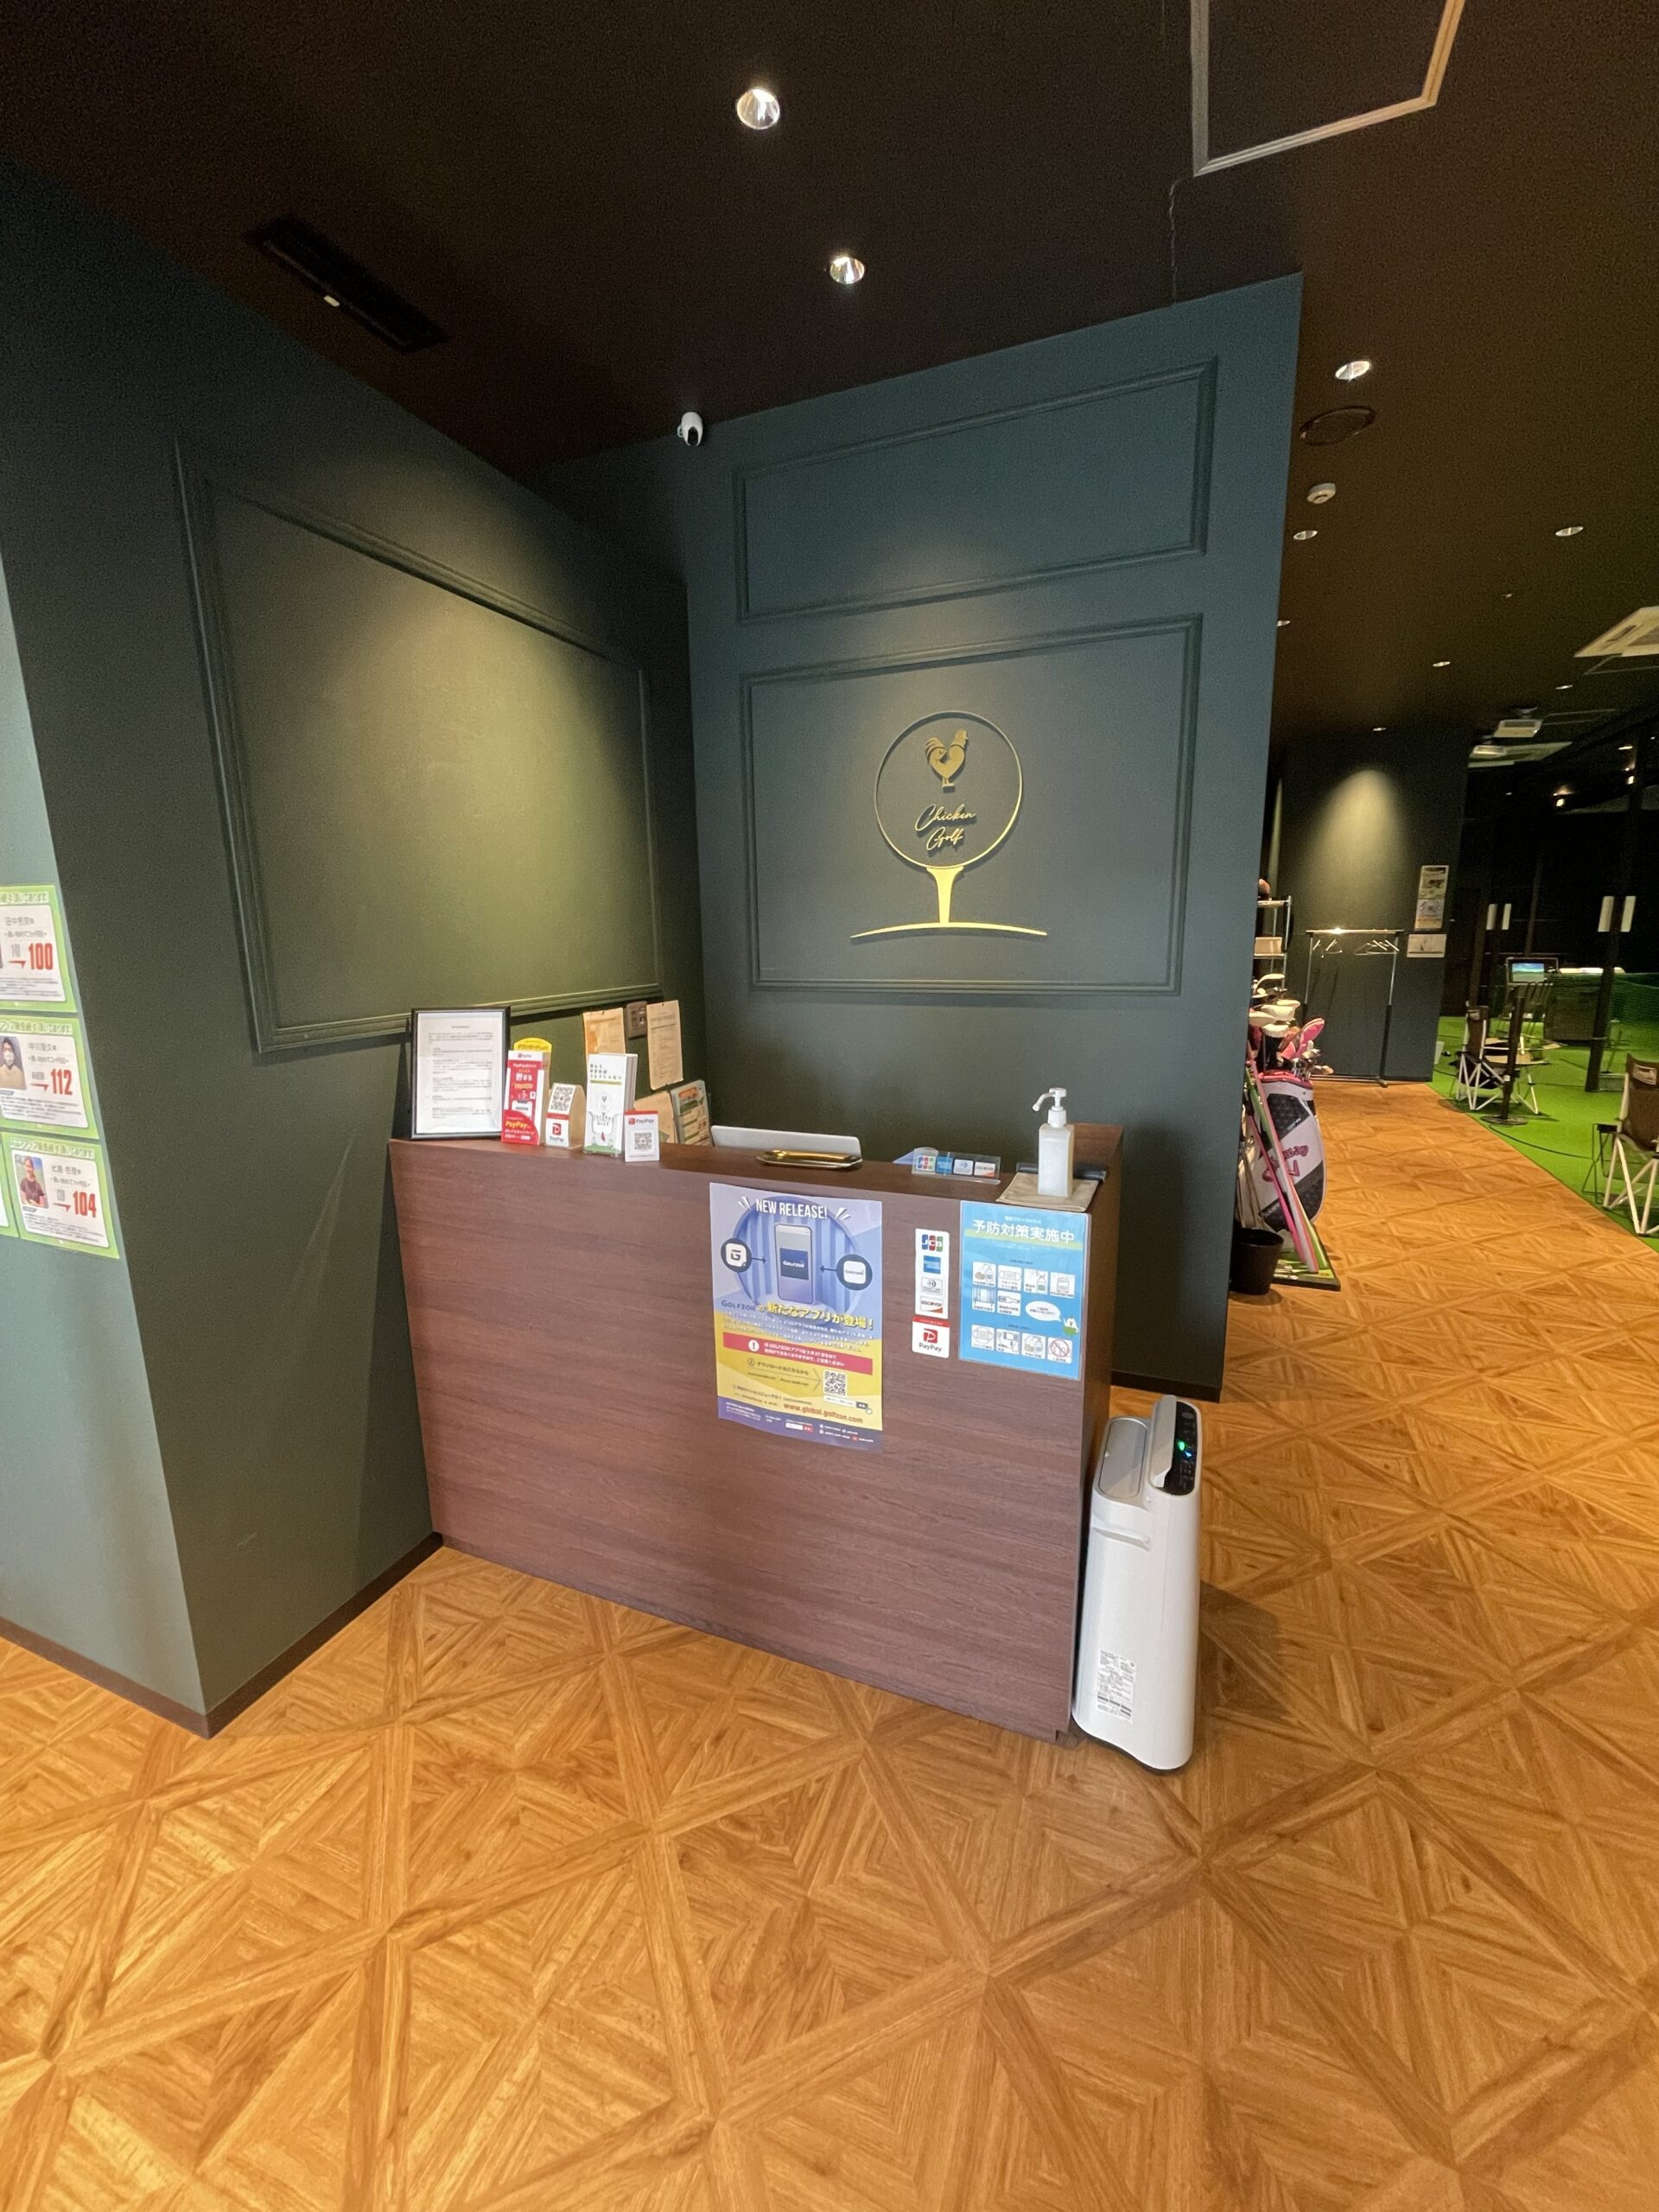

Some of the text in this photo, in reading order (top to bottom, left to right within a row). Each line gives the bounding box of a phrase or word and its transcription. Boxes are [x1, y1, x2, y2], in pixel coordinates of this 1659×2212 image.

[914, 803, 976, 831] Chicken
[925, 826, 964, 851] Golf
[28, 943, 54, 969] 100
[50, 1068, 73, 1096] 112
[73, 1191, 96, 1217] 104
[755, 1198, 828, 1219] NEW RELEASE!
[921, 1236, 944, 1250] JCB
[972, 1218, 1075, 1244] 予防対策実施中
[918, 1342, 943, 1353] PayPay
[783, 1402, 864, 1424] www.global.golfzon.com
